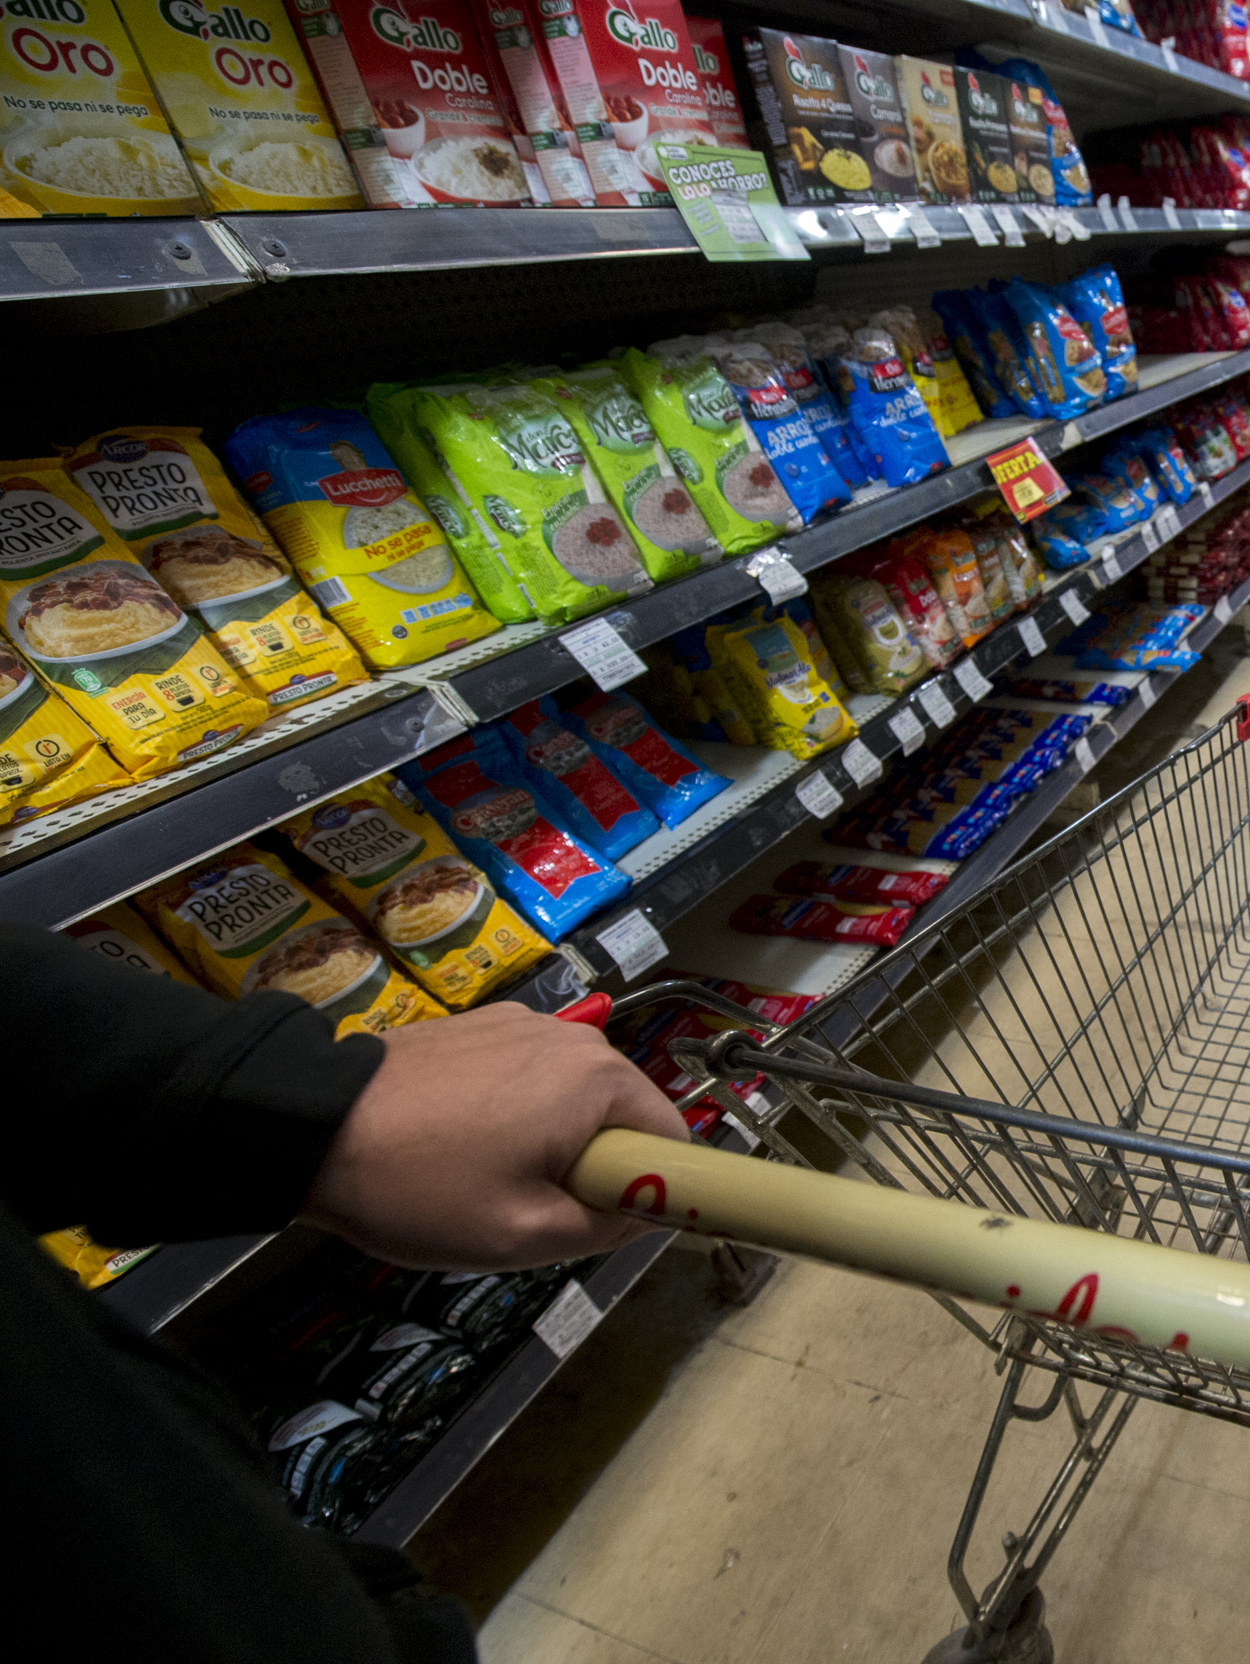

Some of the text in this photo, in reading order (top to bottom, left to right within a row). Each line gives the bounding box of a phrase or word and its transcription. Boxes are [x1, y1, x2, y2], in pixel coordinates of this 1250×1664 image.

[371, 7, 462, 52] Gallo
[606, 8, 679, 53] Gallo
[12, 28, 114, 77] Oro
[692, 45, 719, 75] llo
[215, 47, 293, 89] Oro
[411, 59, 489, 95] Doble
[638, 58, 699, 91] Doble
[786, 56, 836, 91] Gallo
[3, 95, 149, 118] No se pasa ni se pega
[445, 93, 495, 111] Carolina
[664, 88, 704, 107] Carolina
[208, 107, 320, 124] No se pasa ni se pega
[668, 159, 736, 186] CONOCES
[677, 182, 712, 201] LOLO
[87, 462, 186, 494] PRESTO
[323, 473, 402, 497] Lucchetti
[101, 486, 204, 519] PRONTA
[0, 516, 84, 555] RONTA
[364, 523, 433, 561] No se pasa
[250, 623, 277, 637] RINDE
[256, 636, 268, 647] 8
[155, 673, 185, 692] RINDE
[162, 689, 176, 702] 8
[272, 674, 334, 703] PRESTO PRONTA
[111, 690, 148, 711] ENERGÍA
[122, 701, 147, 717] PARA
[127, 707, 157, 725] TU DÍA
[61, 752, 72, 761] EN
[183, 743, 214, 760] PRESTO
[312, 816, 388, 859] PRESTO
[329, 829, 410, 875] PRONTA
[188, 872, 272, 923] PRESTO
[204, 883, 295, 942] PRONTA
